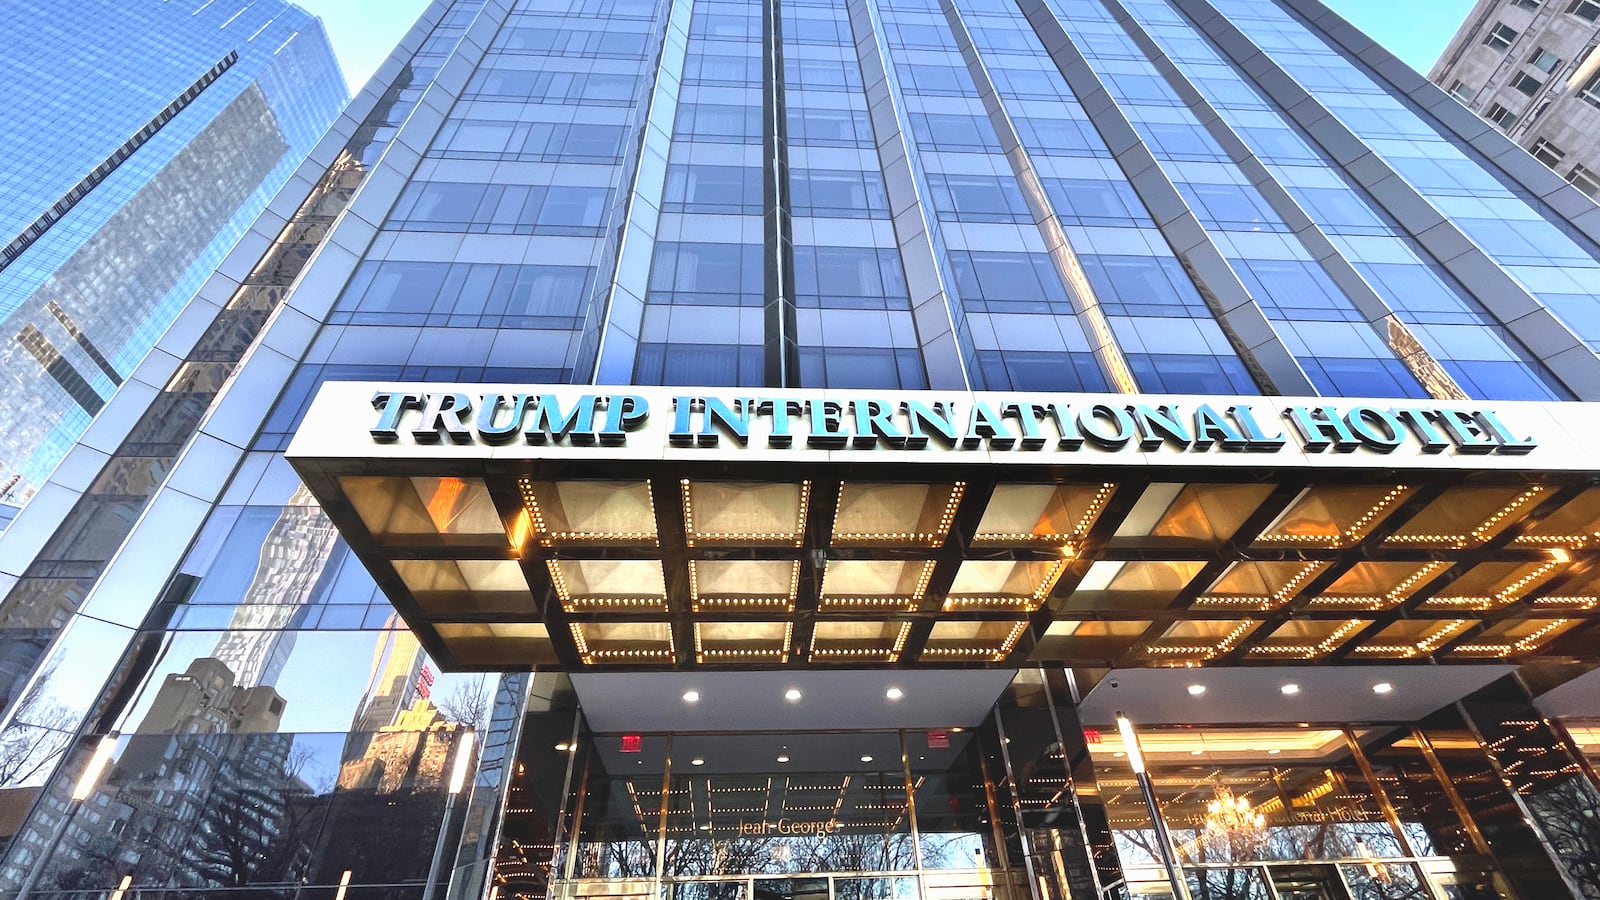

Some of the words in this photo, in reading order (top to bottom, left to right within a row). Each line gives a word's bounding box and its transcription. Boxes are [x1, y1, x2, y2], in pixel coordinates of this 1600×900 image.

[370, 391, 649, 445] TRUMP
[668, 396, 1285, 453] INTERNATIONAL
[1283, 405, 1538, 456] HOTEL
[1327, 804, 1370, 822] Hotel
